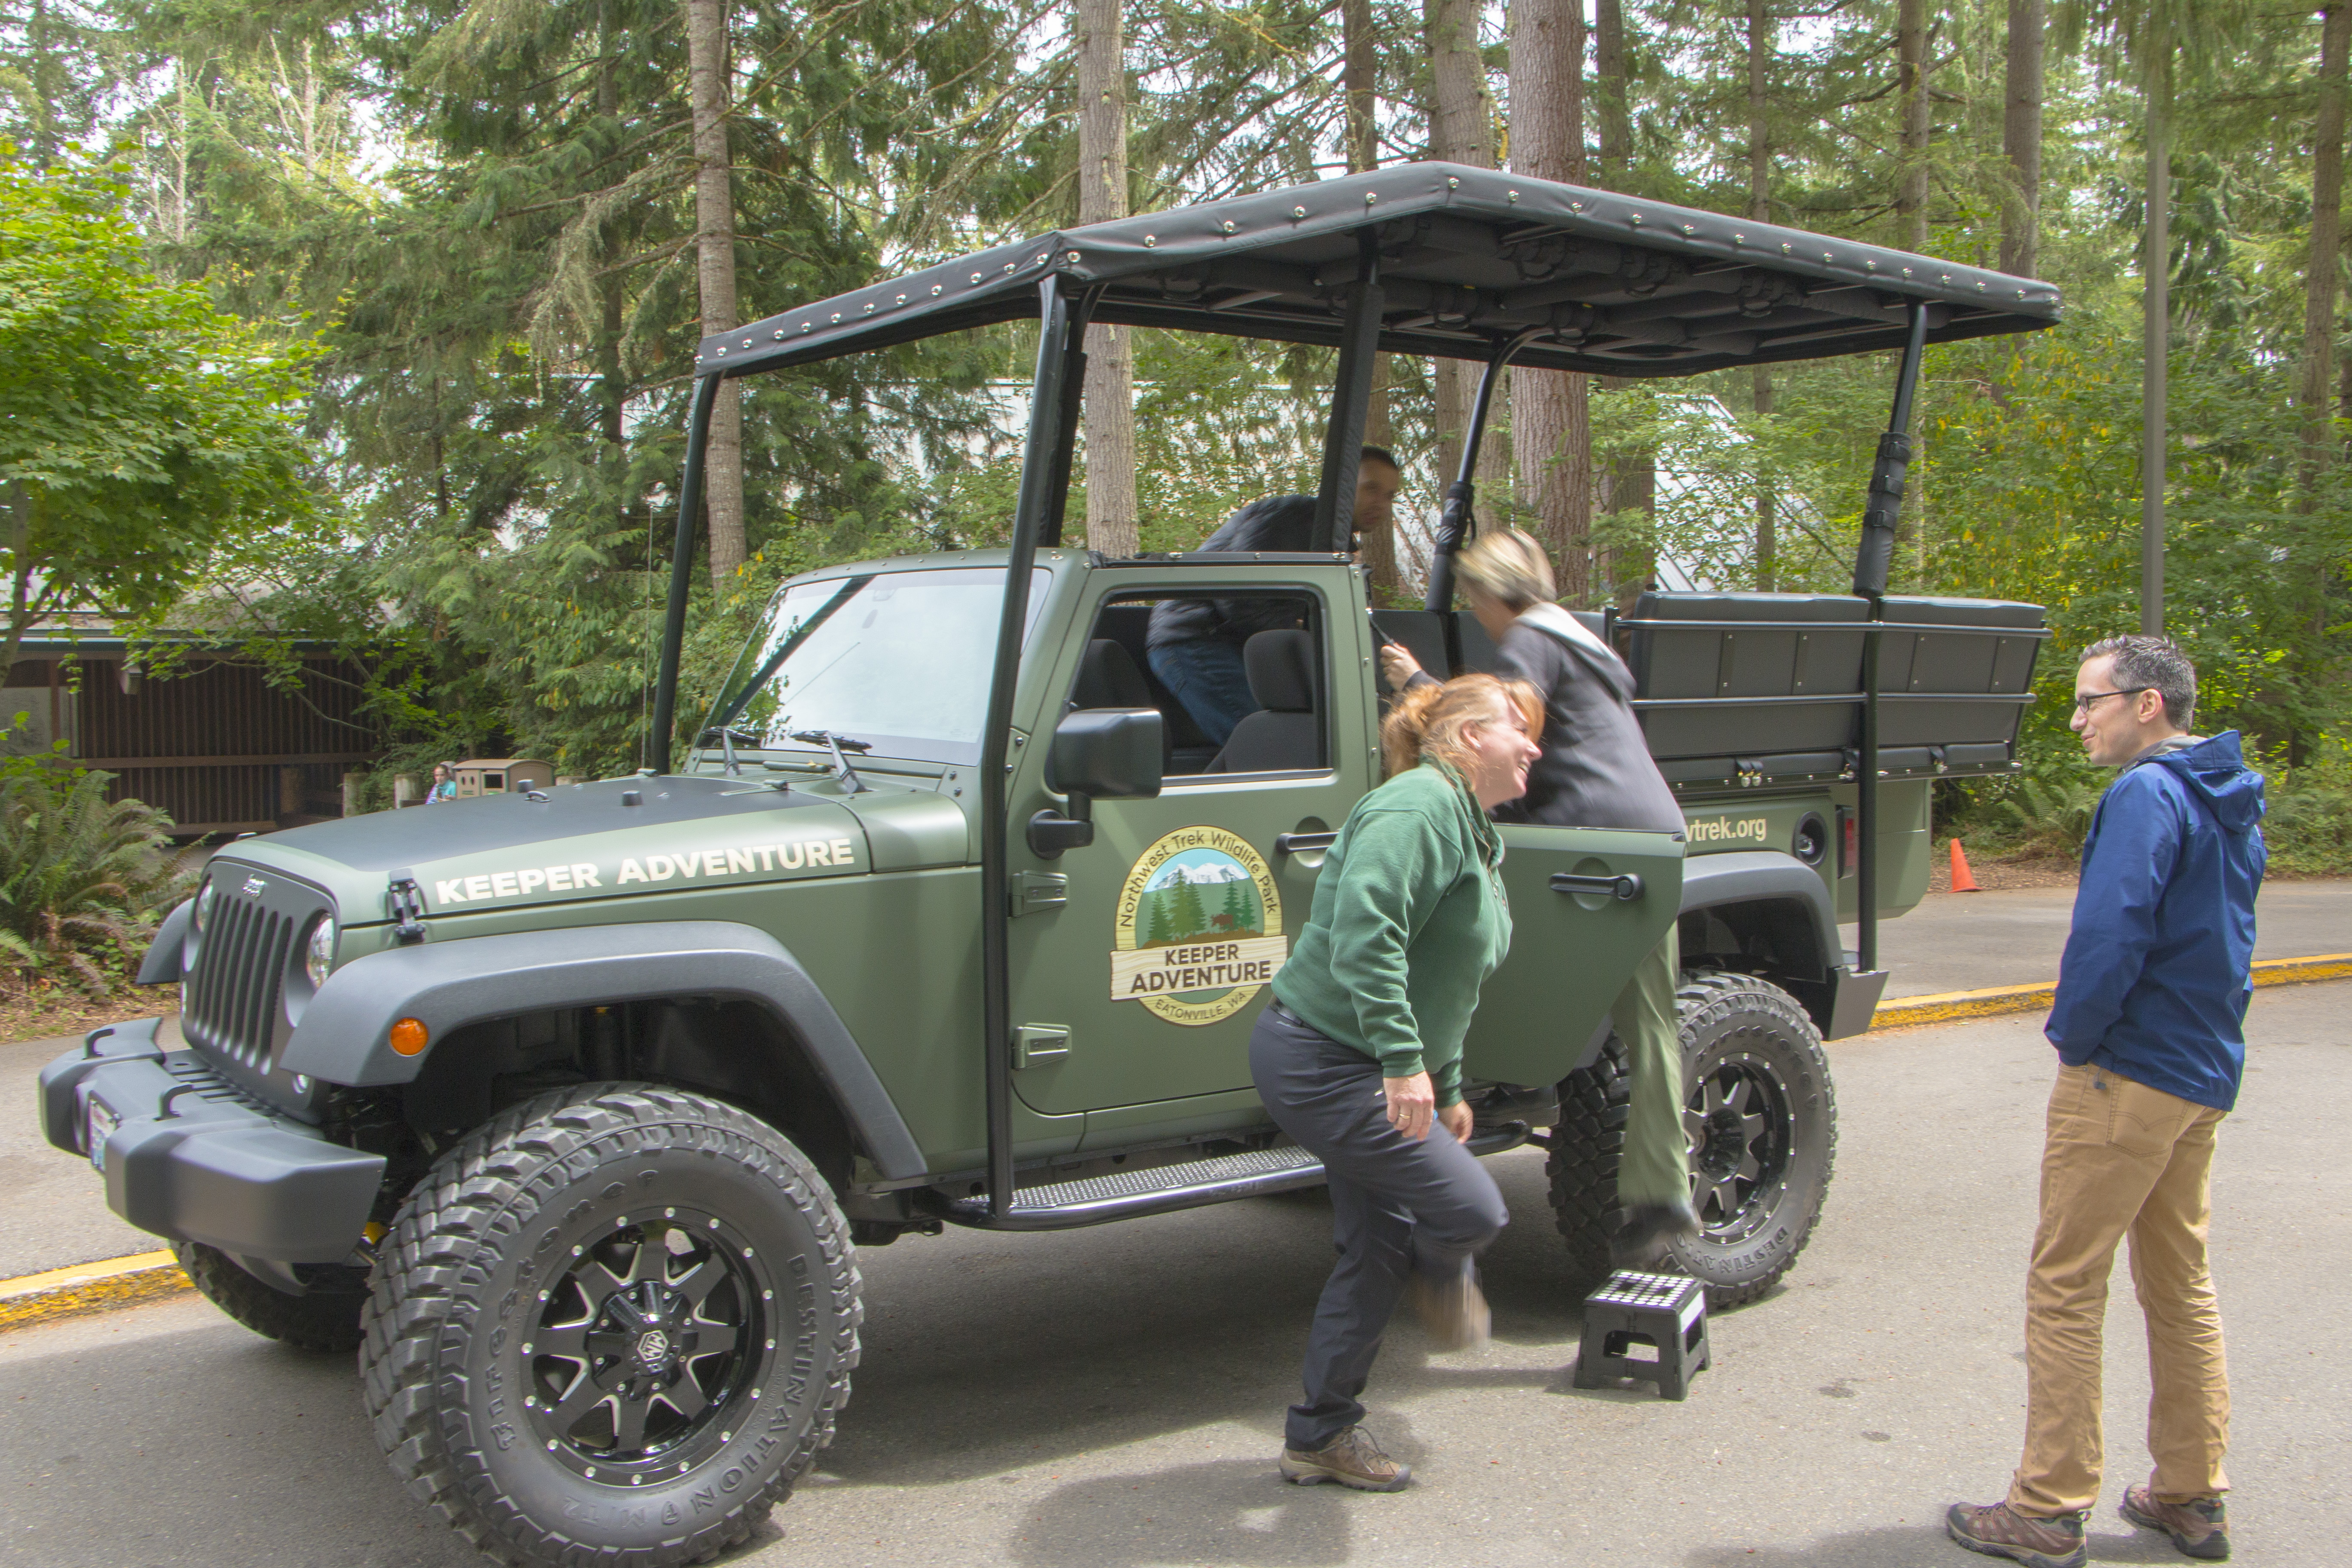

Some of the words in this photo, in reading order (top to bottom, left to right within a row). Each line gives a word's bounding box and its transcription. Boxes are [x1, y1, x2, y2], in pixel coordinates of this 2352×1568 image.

[435, 863, 603, 905] KEEPER
[617, 839, 855, 885] ADVENTURE
[1120, 844, 1170, 927] Northwest
[1171, 830, 1205, 849] Trek
[1211, 831, 1260, 874] Wildlife
[1258, 875, 1277, 914] Park
[1130, 960, 1271, 994] ADVENTURE
[1165, 944, 1239, 966] KEEPER
[1228, 992, 1246, 1008] WA
[1676, 1226, 1788, 1274] DESTINATIO
[690, 1253, 817, 1514] DESTINATION
